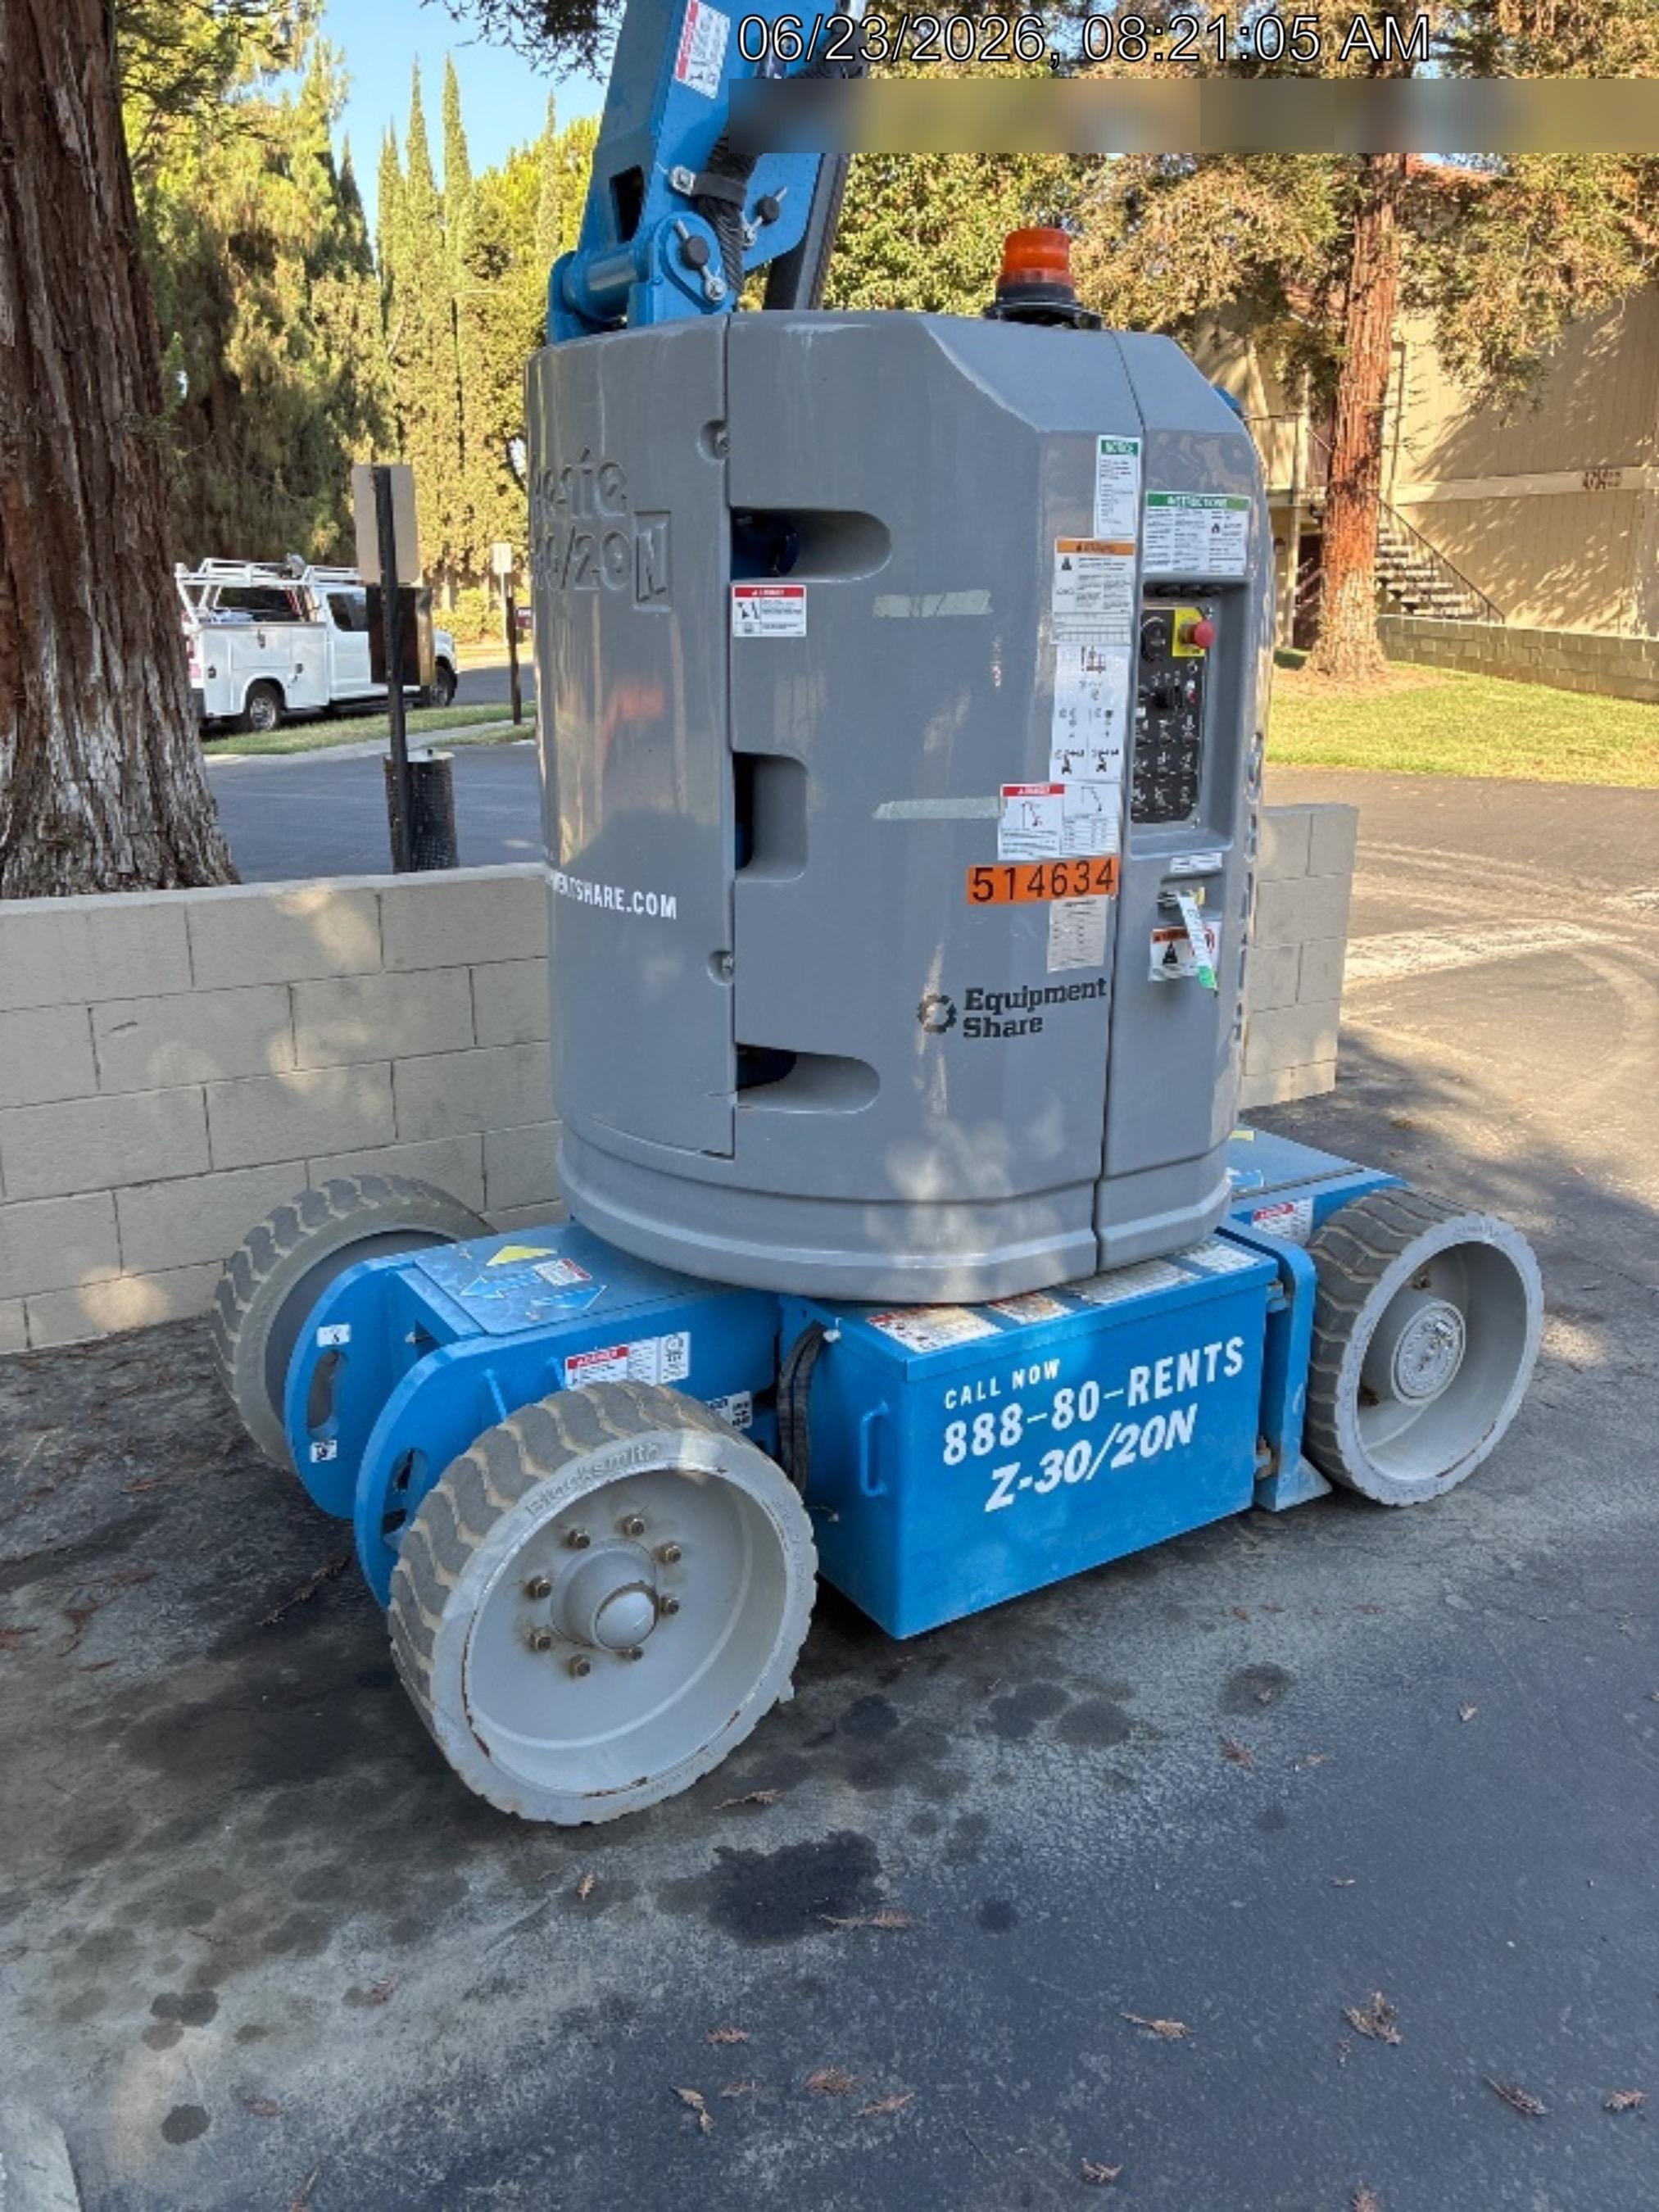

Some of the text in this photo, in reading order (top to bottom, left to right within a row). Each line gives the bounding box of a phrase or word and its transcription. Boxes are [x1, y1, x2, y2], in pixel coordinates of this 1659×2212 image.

[972, 858, 1114, 902] 514634
[963, 977, 1107, 1013] Equipment
[963, 1016, 1044, 1039] Share
[943, 1335, 1244, 1466] 888-80-RENTS
[945, 1358, 1060, 1410] CALL NOW
[984, 1403, 1199, 1512] Z-30/20N
